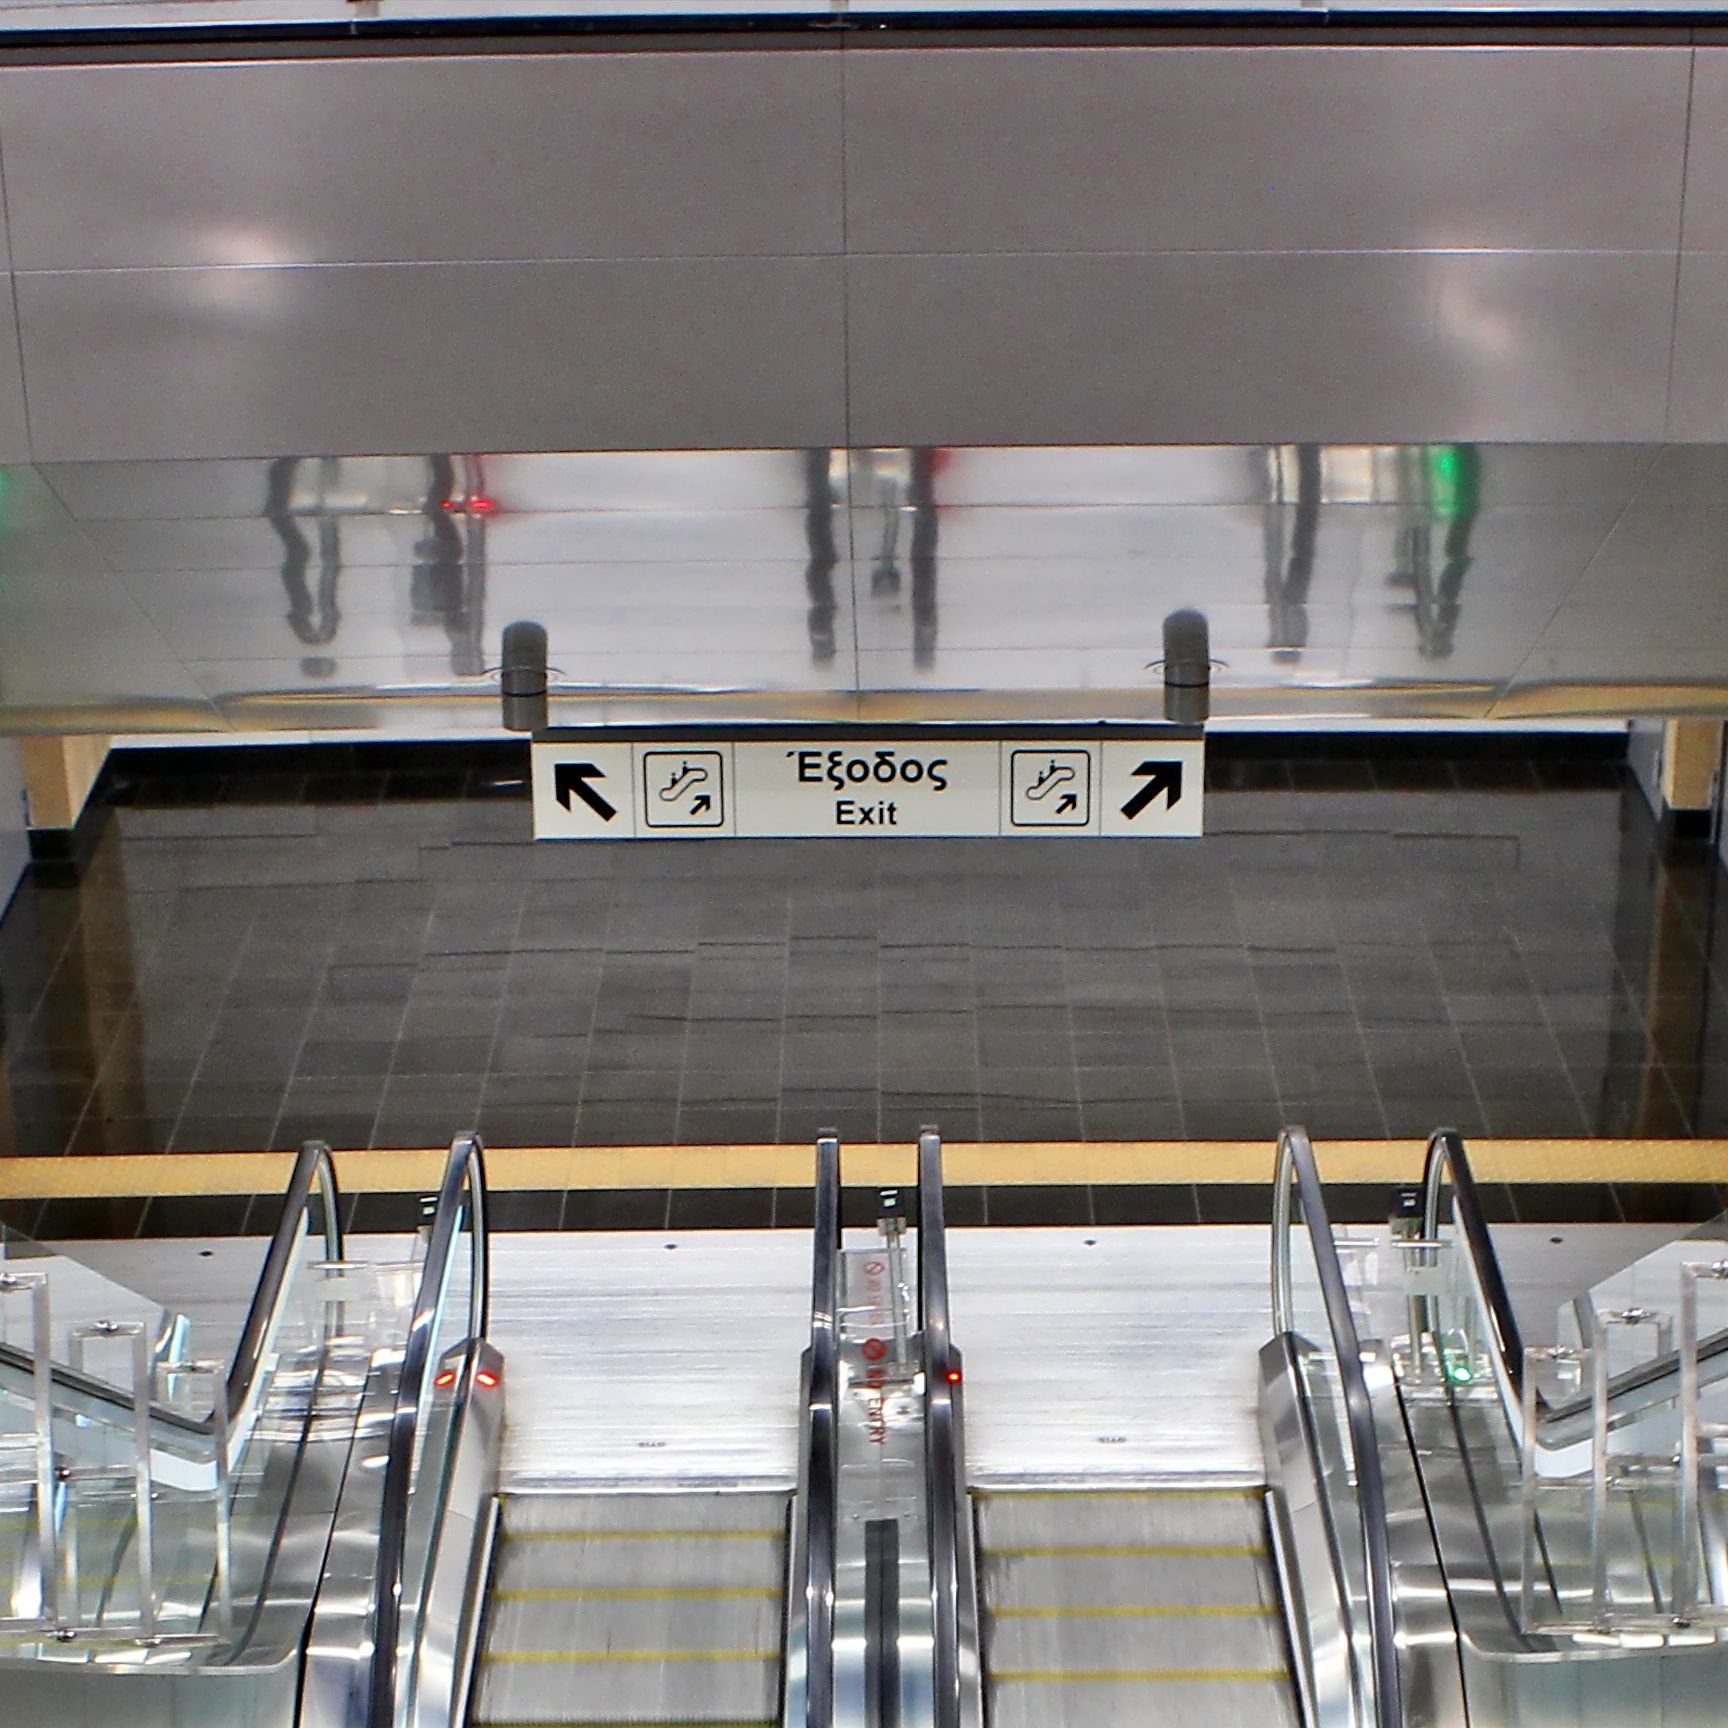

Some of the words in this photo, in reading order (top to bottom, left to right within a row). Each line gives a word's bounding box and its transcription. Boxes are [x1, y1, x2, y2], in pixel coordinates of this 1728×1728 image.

[786, 750, 949, 792] Έξοδος
[835, 800, 898, 826] Exit
[867, 1397, 886, 1445] ENTRY
